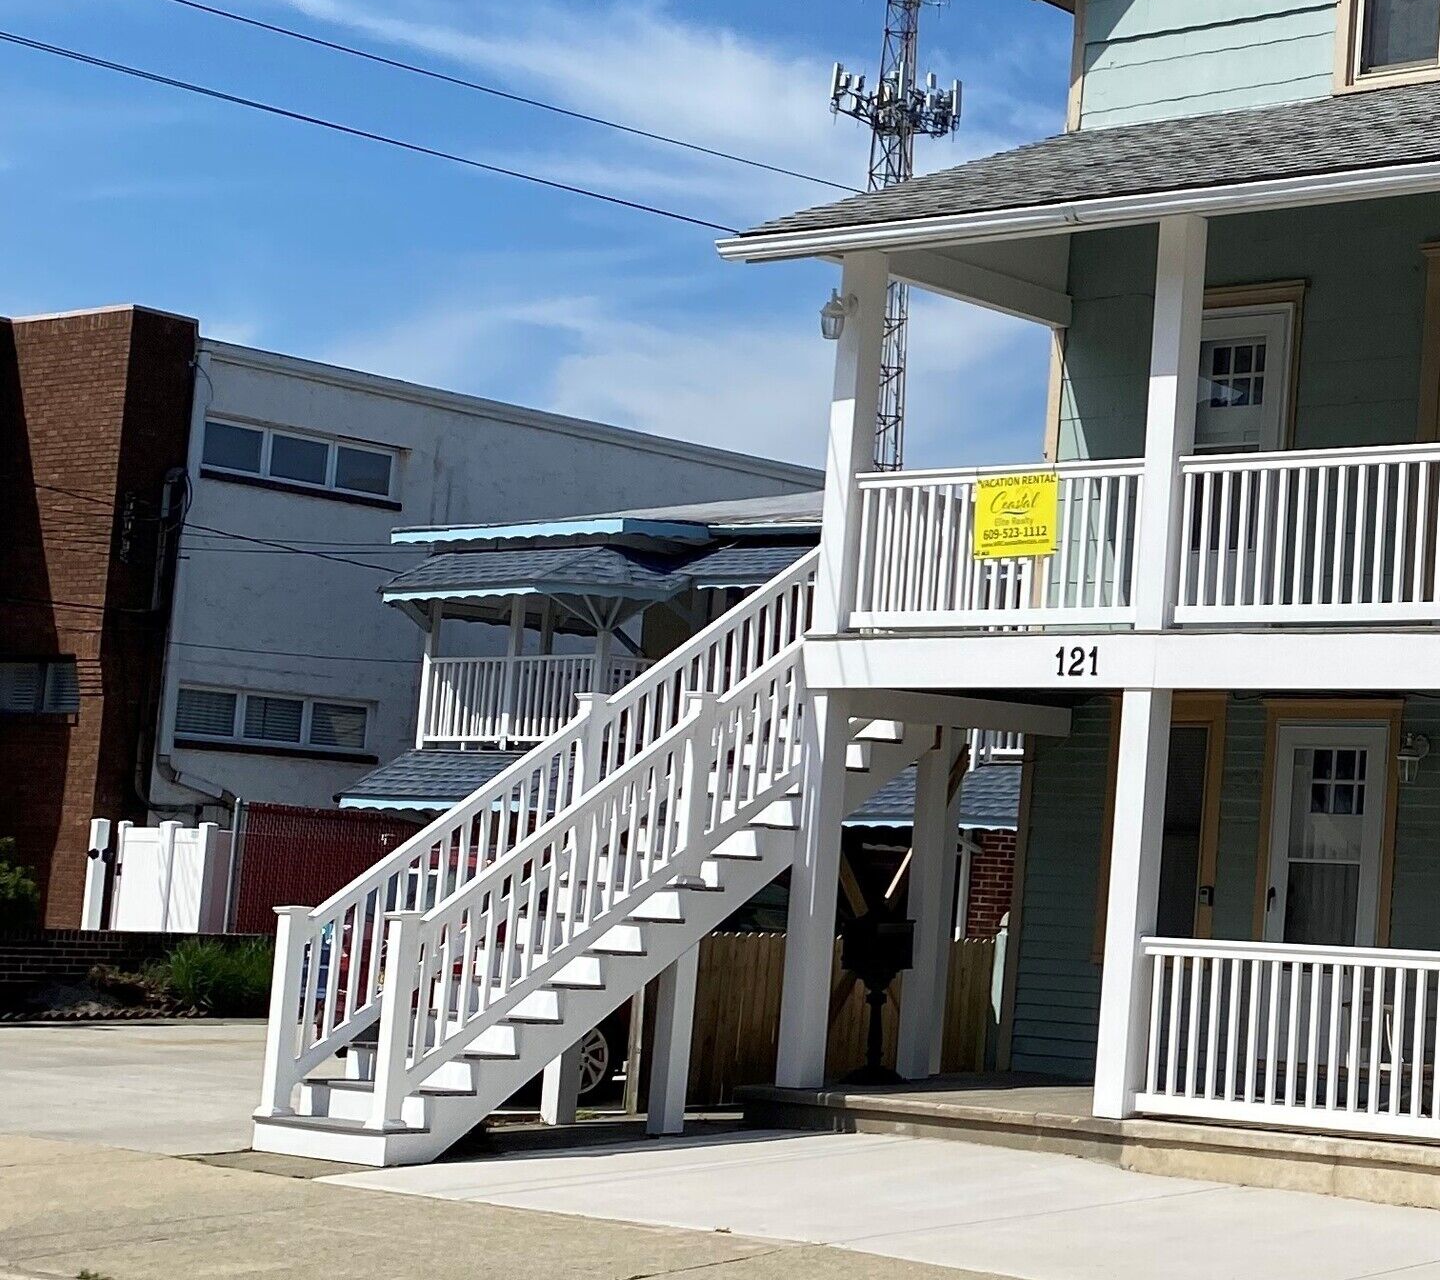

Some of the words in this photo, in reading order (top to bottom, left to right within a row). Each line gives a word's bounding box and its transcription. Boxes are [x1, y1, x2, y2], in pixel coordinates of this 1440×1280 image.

[979, 477, 1020, 488] VACATION
[1022, 474, 1056, 484] RENTAL
[990, 491, 1040, 514] Coastal
[983, 526, 1047, 540] 609-523-1112
[1056, 646, 1098, 677] 121
